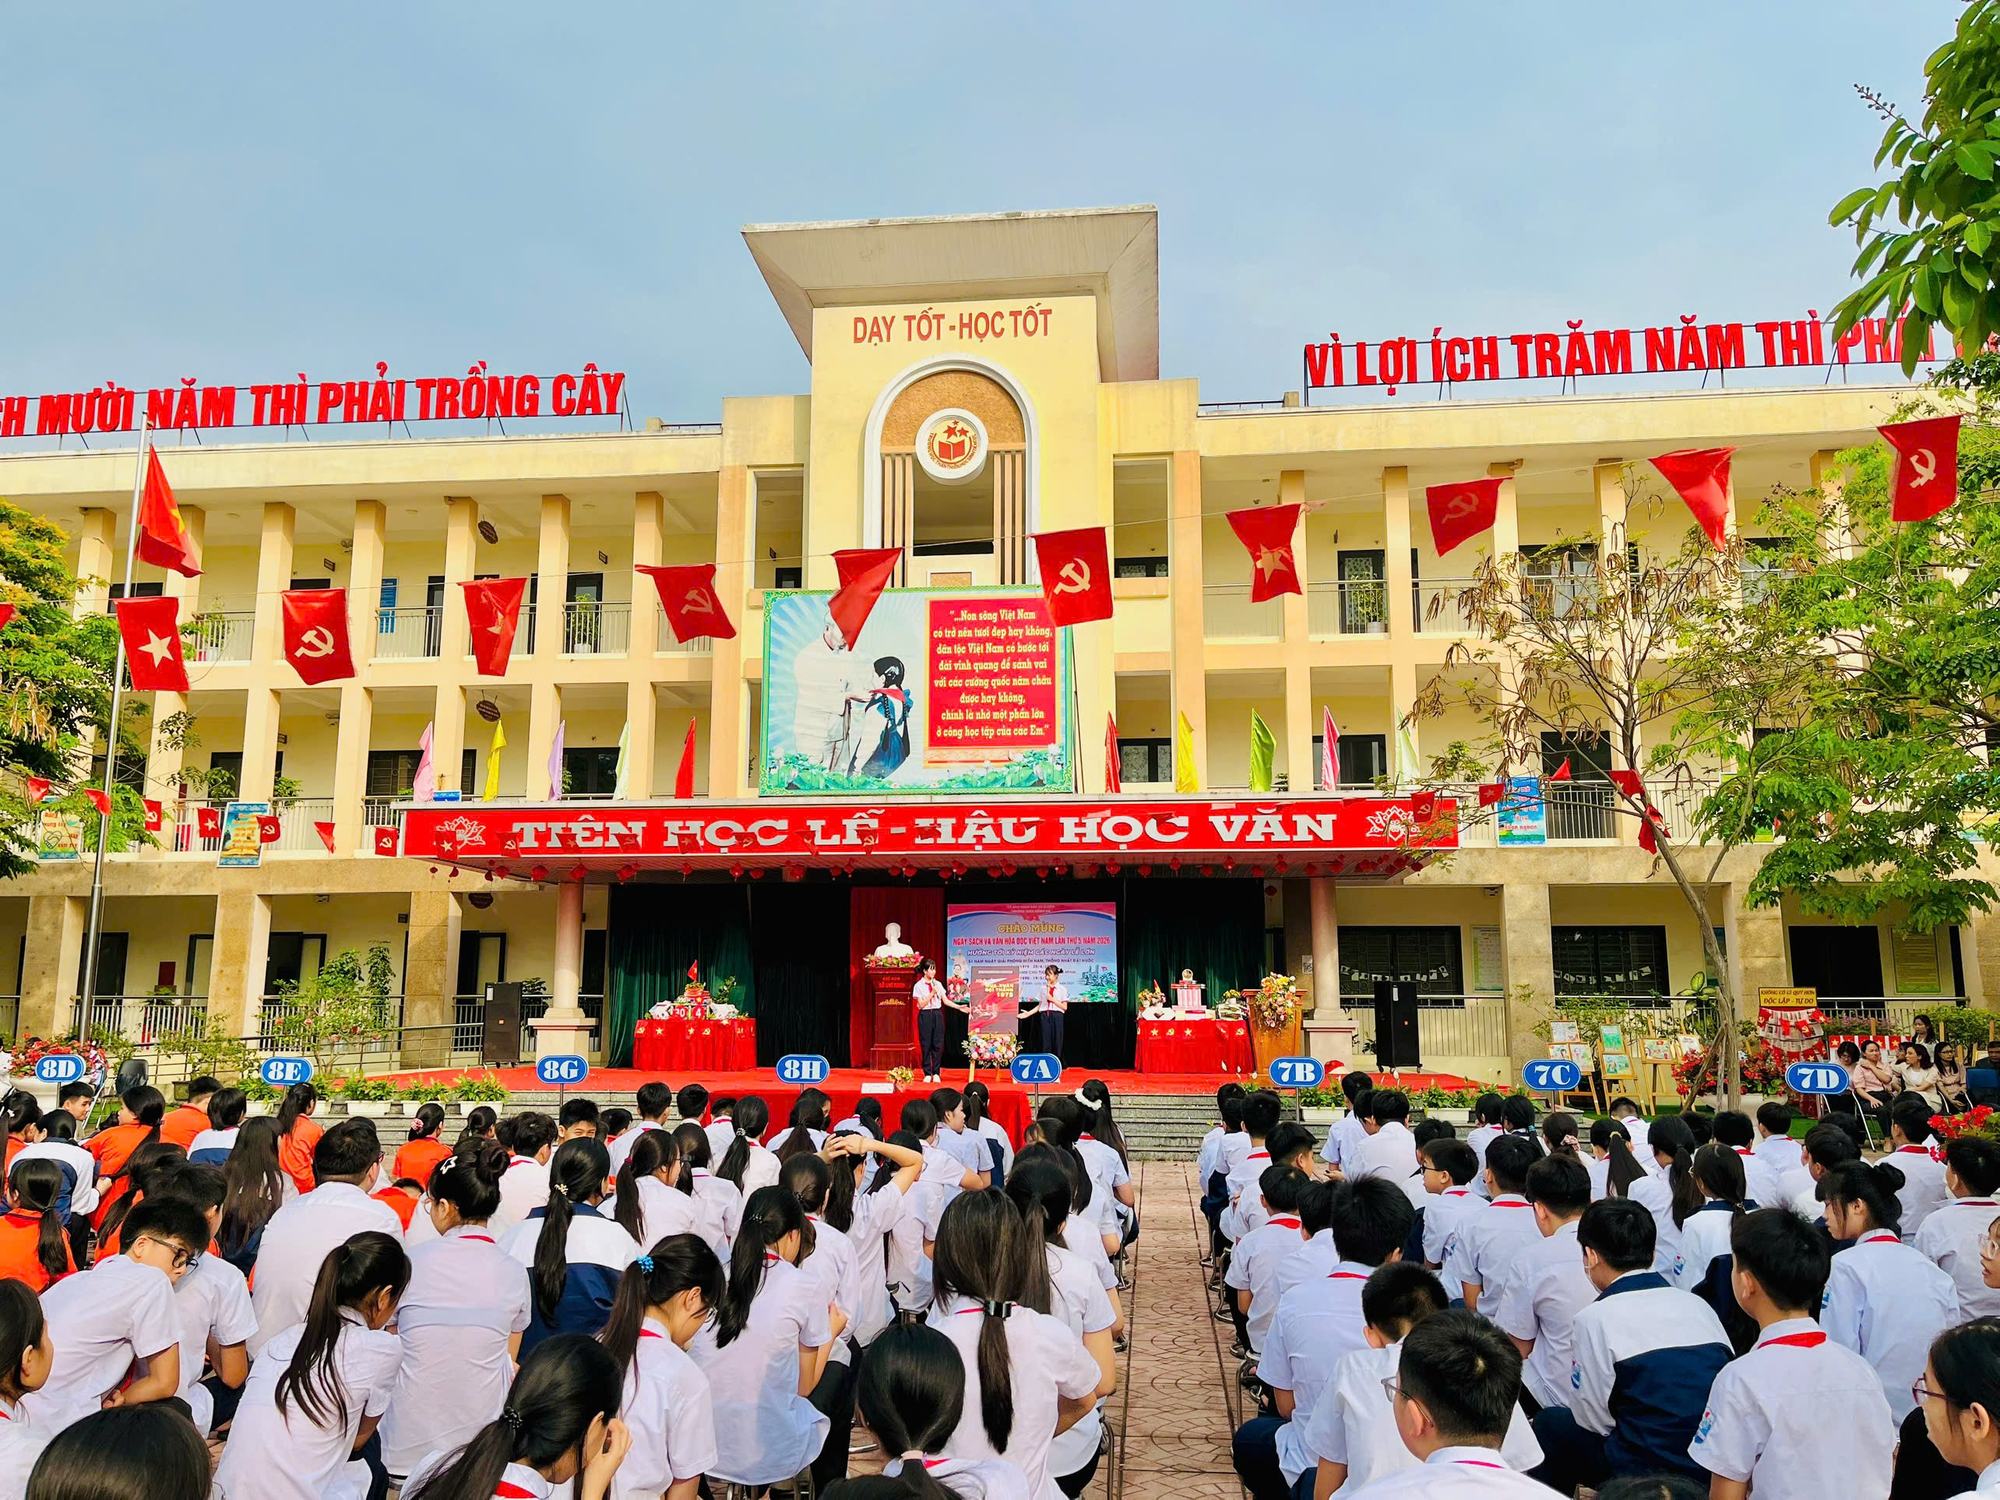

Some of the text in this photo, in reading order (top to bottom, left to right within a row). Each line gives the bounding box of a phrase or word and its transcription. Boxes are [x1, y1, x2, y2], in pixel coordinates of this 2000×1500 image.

[854, 315, 896, 346] DẠY
[904, 306, 946, 342] TỐT
[959, 310, 1005, 343] HỌC
[1009, 302, 1052, 338] TỐT
[1306, 333, 1342, 387] VÌ
[1356, 341, 1417, 396] LỢI
[1433, 326, 1499, 382] ÍCH
[1510, 319, 1631, 378] TRĂM
[1644, 314, 1743, 372] NĂM
[1755, 310, 1823, 366] THÌ
[37, 381, 134, 434] MƯỜI
[146, 377, 235, 430] NĂM
[250, 373, 308, 425] THÌ
[318, 360, 406, 423] PHẢI
[415, 360, 542, 420] TRỒNG
[553, 362, 626, 416] CÂY
[978, 612, 997, 622] sông
[1000, 609, 1016, 622] Việt
[1017, 608, 1036, 620] Nam
[933, 626, 1052, 639] có trở nên tươi đẹp hay không,
[937, 642, 1048, 656] dân tộc Việt Nam có bước tới
[938, 657, 1047, 672] đài vinh quang để sánh vai
[934, 675, 1052, 689] với các cường quốc năm châu
[960, 692, 1026, 706] được hay không,
[942, 708, 1044, 722] chính là nhờ một phần lớn
[936, 726, 941, 737] ở
[944, 727, 962, 738] công
[965, 726, 978, 738] học
[981, 726, 994, 738] tập
[996, 725, 1012, 736] của
[1014, 725, 1028, 736] các
[512, 814, 647, 848] TIÊN
[663, 820, 789, 854] HỌC
[915, 809, 1043, 851] HẬU
[1059, 815, 1189, 850] HỌC
[1208, 807, 1338, 842] VĂN
[997, 921, 1066, 933] CHÀO MỪNG
[42, 1060, 78, 1081] 8D
[268, 1061, 304, 1082] 8E
[544, 1060, 580, 1082] 8G
[784, 1060, 822, 1081] 8H
[1018, 1059, 1053, 1080] 7A
[1276, 1060, 1317, 1083] 7B
[1534, 1064, 1571, 1086] 7C
[1797, 1067, 1839, 1089] 7D
